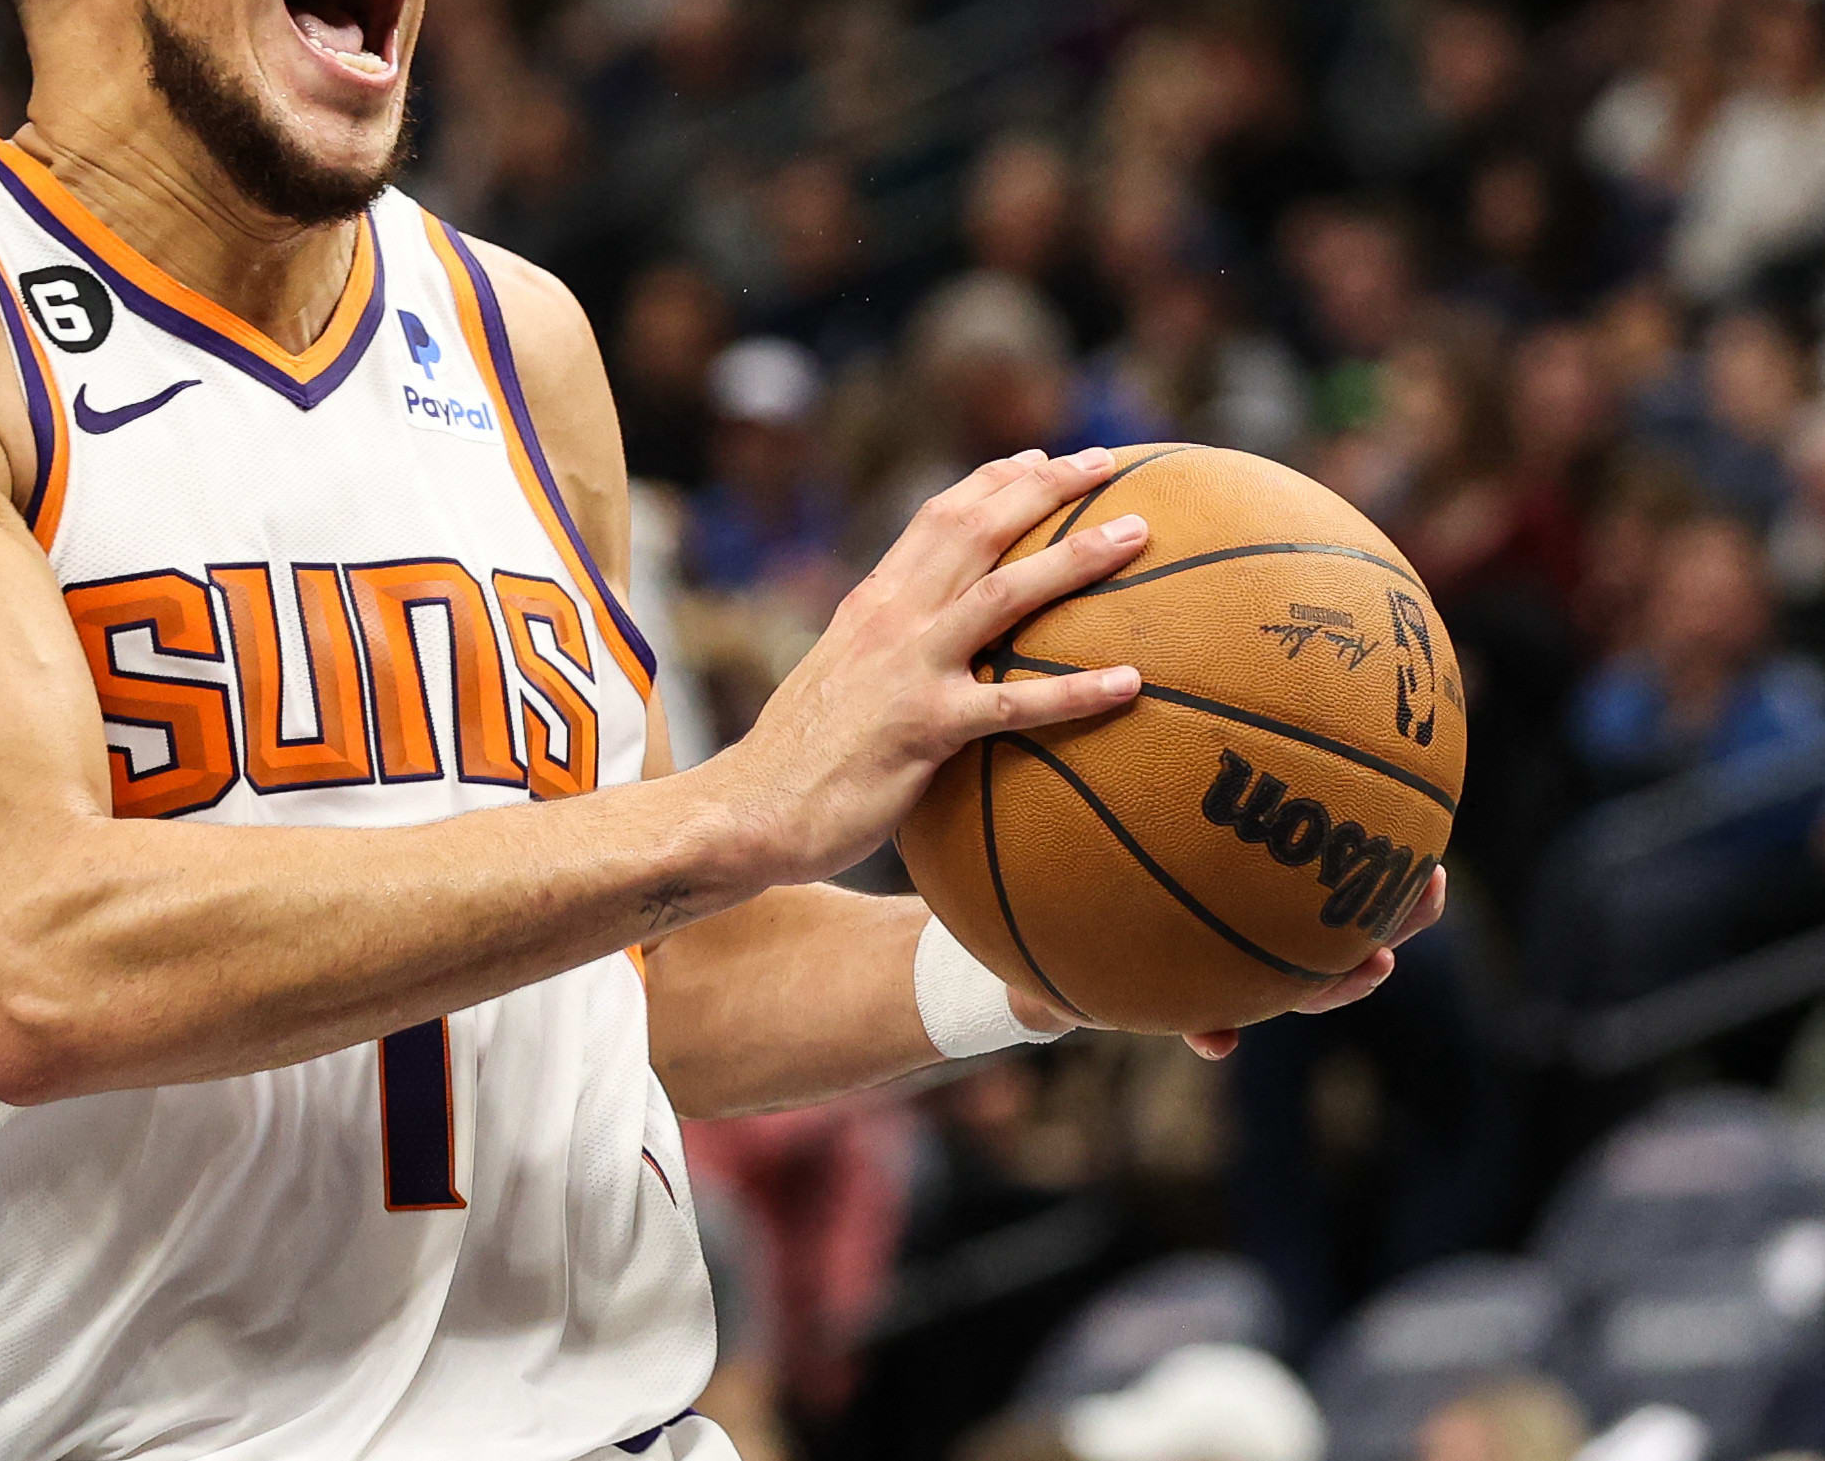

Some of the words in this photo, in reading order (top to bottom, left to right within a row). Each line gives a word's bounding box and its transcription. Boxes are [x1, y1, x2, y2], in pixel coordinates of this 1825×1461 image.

[29, 279, 94, 342] 6
[403, 385, 493, 430] PayPal
[63, 557, 599, 819] SUNS
